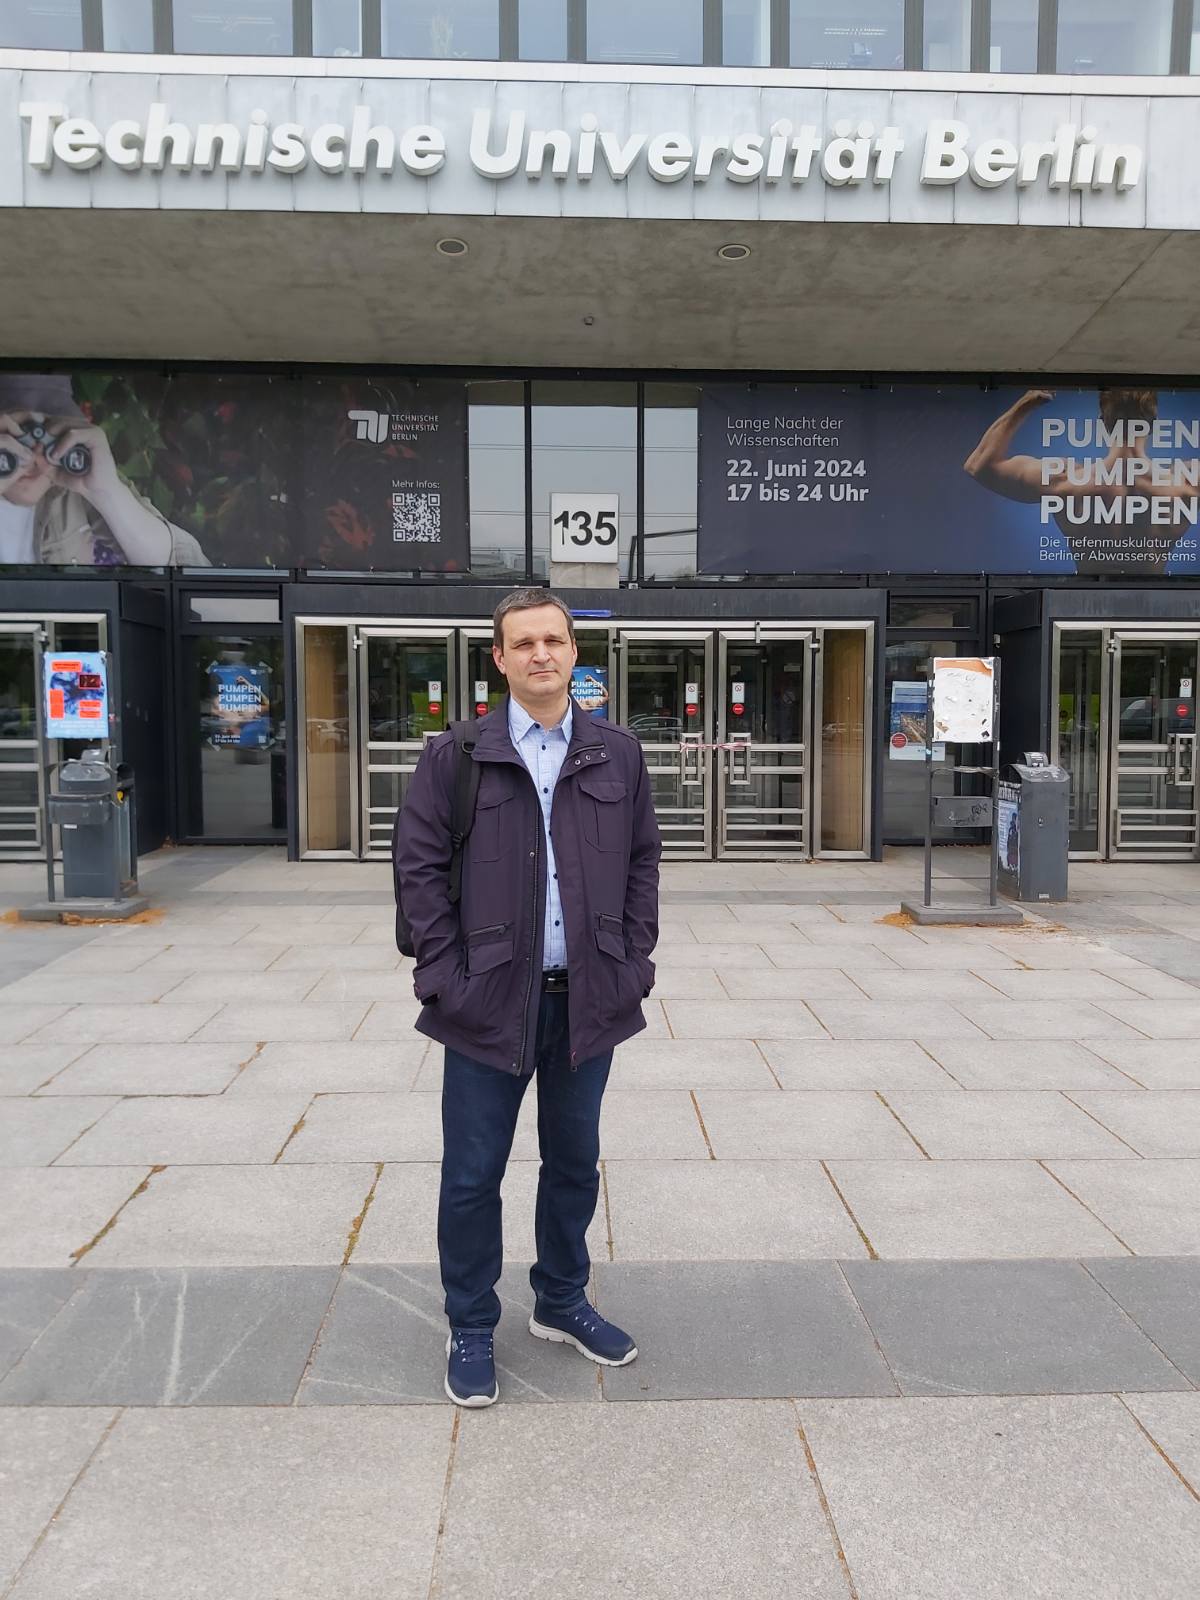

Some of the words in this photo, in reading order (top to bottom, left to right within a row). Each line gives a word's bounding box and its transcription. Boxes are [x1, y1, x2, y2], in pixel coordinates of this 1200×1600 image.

[19, 102, 446, 176] Technische
[469, 110, 905, 187] Universität
[919, 119, 1145, 192] Berlin
[391, 414, 439, 422] TECHNISCHE
[727, 416, 770, 432] Lange
[774, 416, 817, 430] Nacht
[820, 416, 844, 430] der
[391, 423, 439, 432] UNIVERSITÄT
[1042, 418, 1200, 448] PUMPEN
[391, 433, 418, 441] BERLIN
[727, 433, 840, 447] Wissenschaften
[726, 459, 759, 477] 22.
[764, 458, 807, 481] Juni
[814, 459, 867, 477] 2024
[1041, 457, 1199, 487] PUMPEN
[392, 480, 414, 488] Mehr
[416, 480, 441, 489] Infos:
[727, 483, 753, 501] 17
[759, 483, 791, 501] bis
[797, 483, 823, 502] 24
[829, 483, 869, 502] Uhr
[1040, 495, 1198, 525] PUMPEN
[554, 510, 617, 546] 135
[1039, 536, 1061, 548] Die
[1064, 536, 1172, 548] Tiefenmuskulatur
[1175, 537, 1197, 548] des
[1039, 550, 1086, 561] Berliner
[1088, 550, 1197, 564] Abwassersystems
[218, 684, 261, 693] PUMPEN
[218, 694, 261, 702] PUMPEN
[218, 703, 261, 712] PUMPEN
